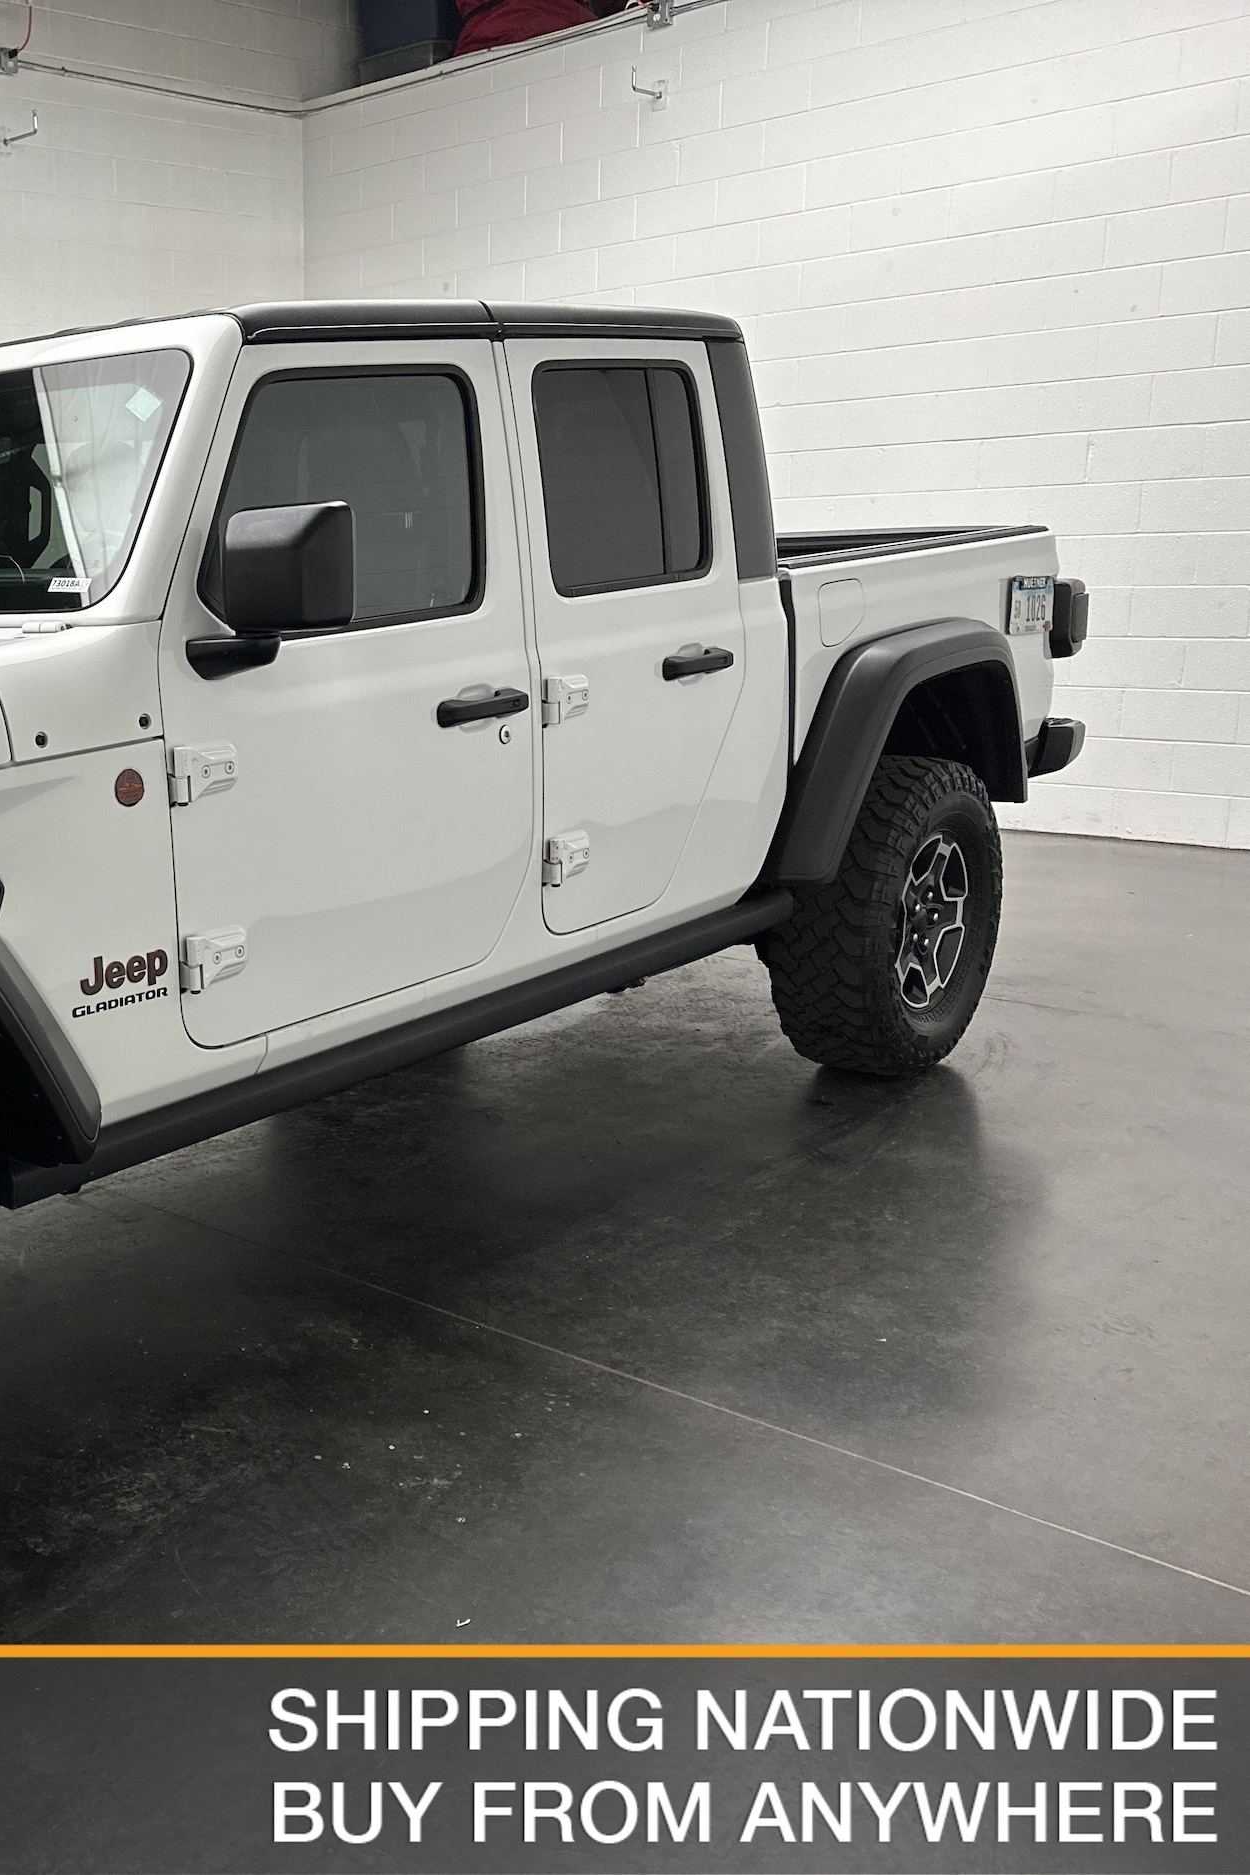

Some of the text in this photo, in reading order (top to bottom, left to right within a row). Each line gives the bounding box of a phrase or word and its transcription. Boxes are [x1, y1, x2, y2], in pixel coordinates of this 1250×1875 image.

[1026, 594, 1046, 622] 1026
[80, 949, 168, 995] Jeep
[72, 987, 168, 1018] GLADIATOR
